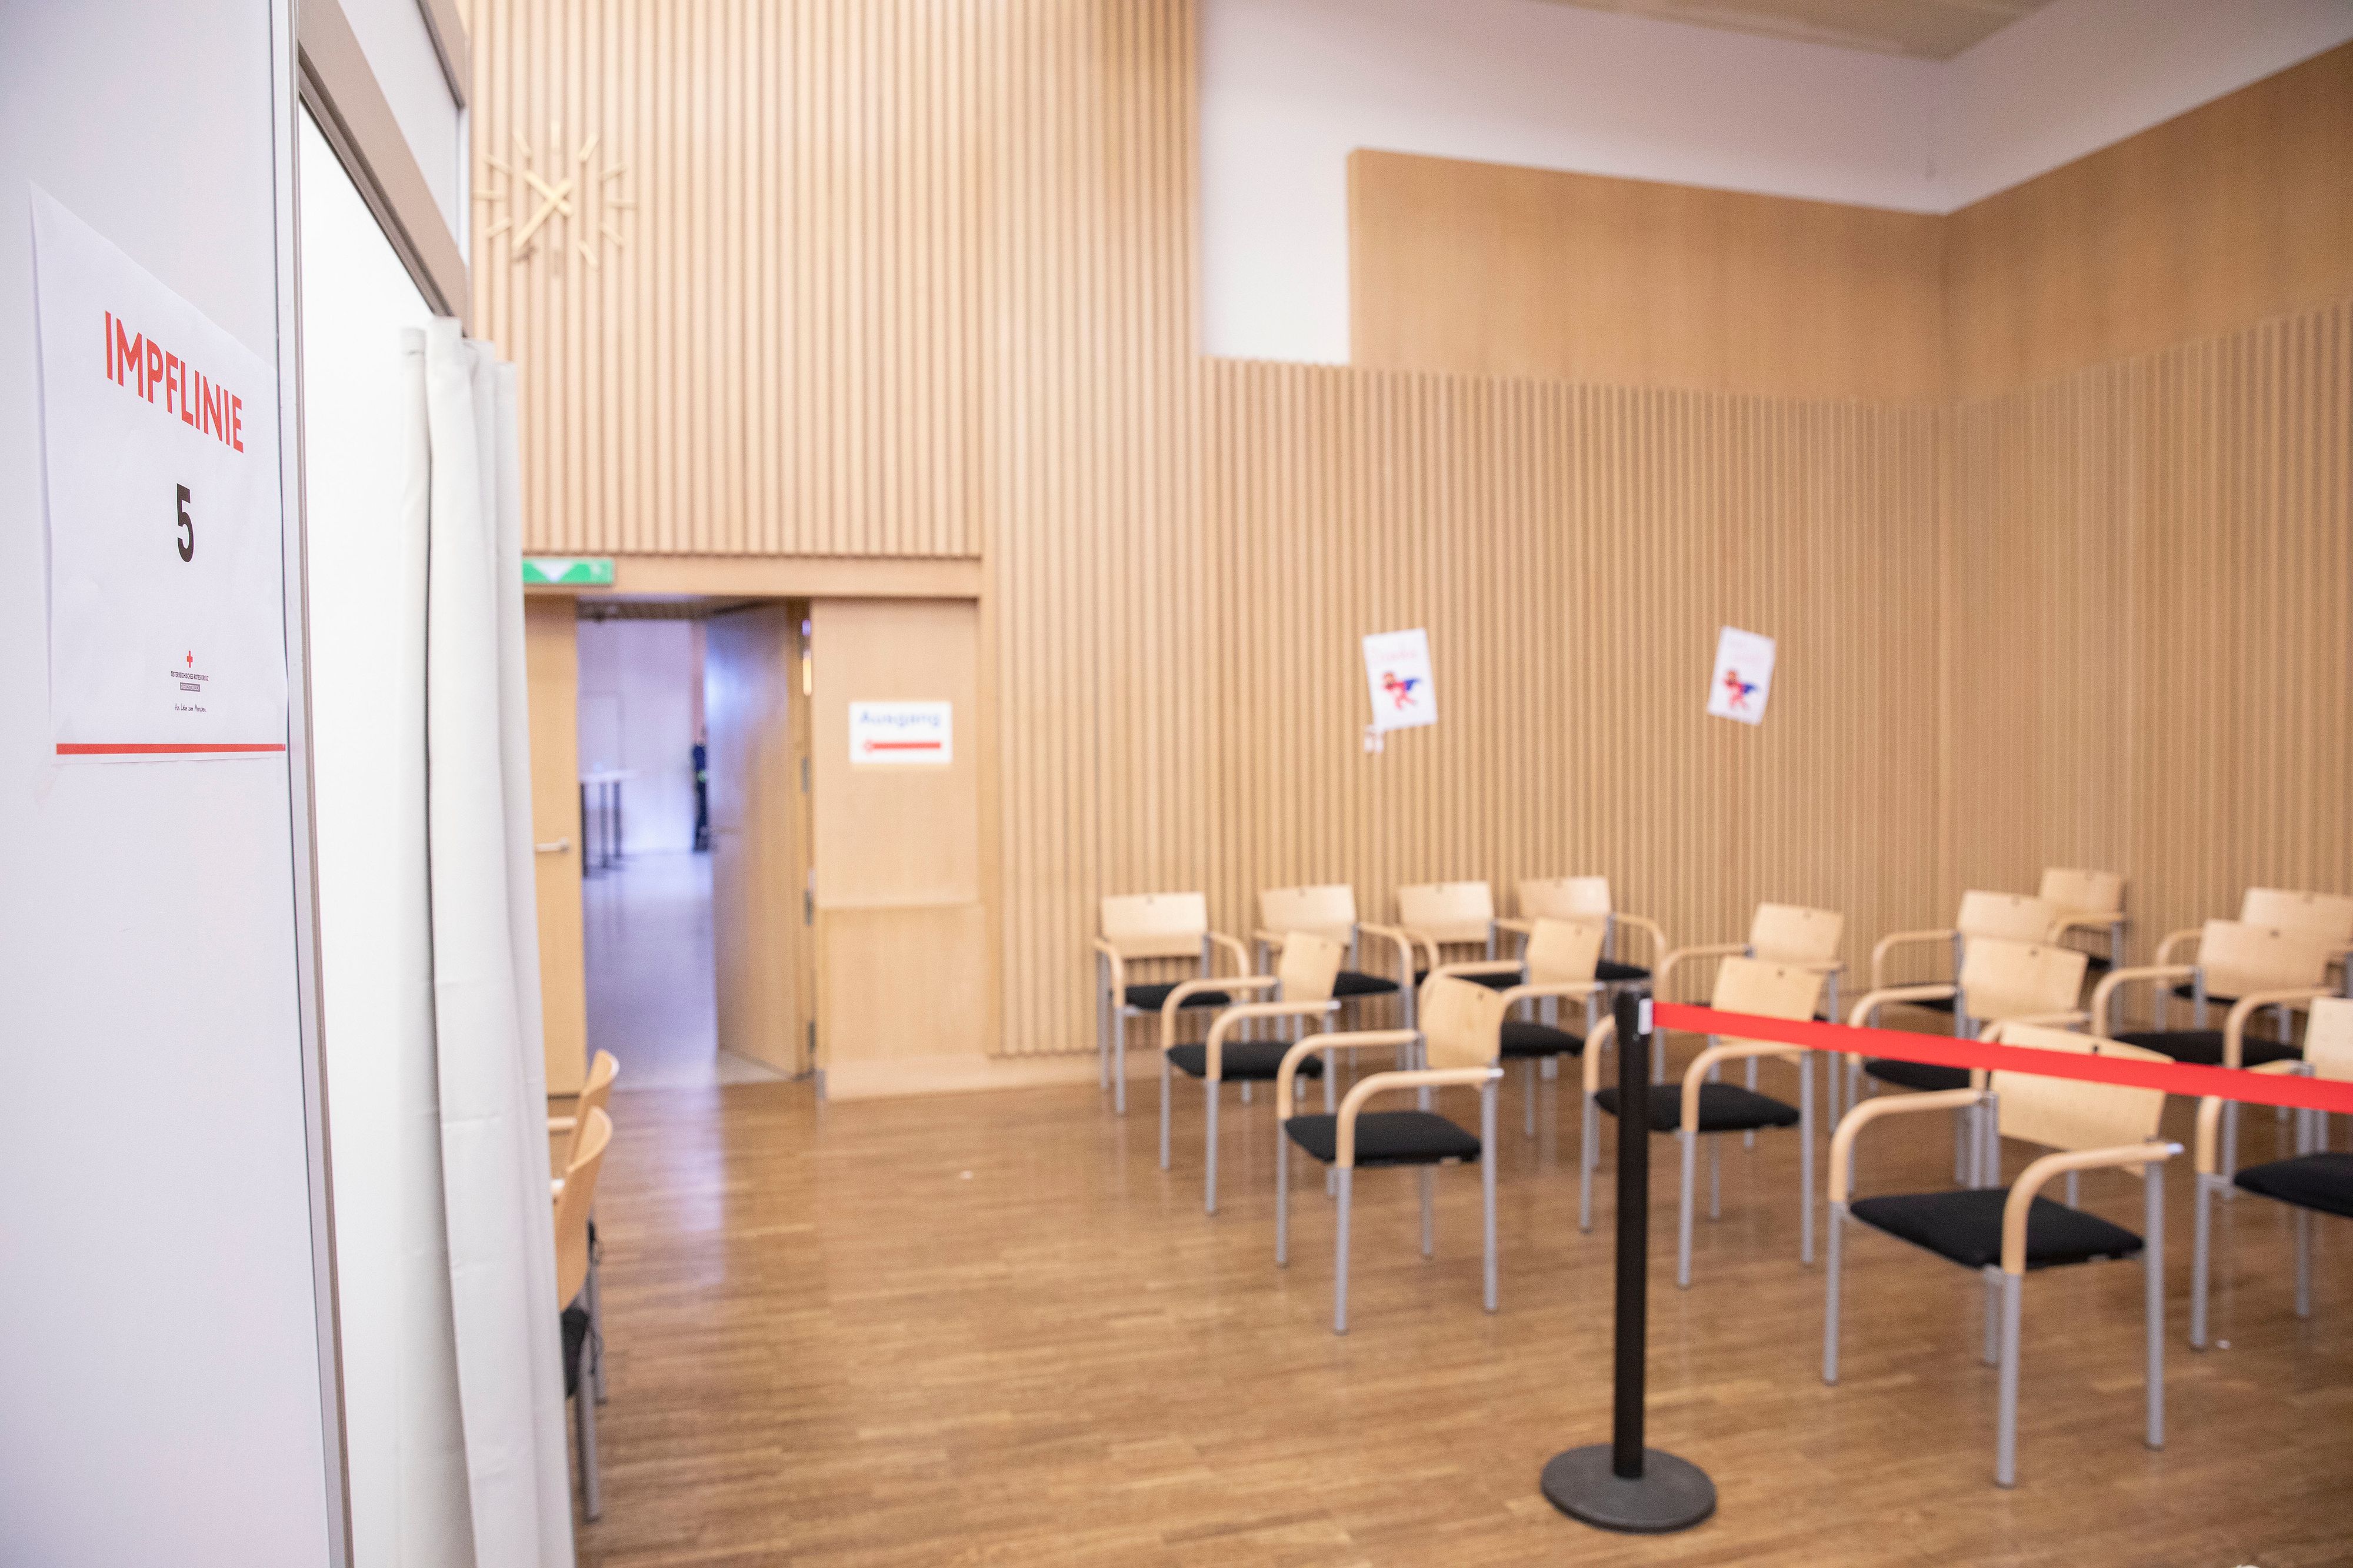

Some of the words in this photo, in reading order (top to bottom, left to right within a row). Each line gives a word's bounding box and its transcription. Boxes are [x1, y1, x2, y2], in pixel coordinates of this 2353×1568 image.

[105, 310, 244, 453] IMPFLINIE
[176, 483, 194, 562] 5
[860, 711, 940, 729] Ausgang
